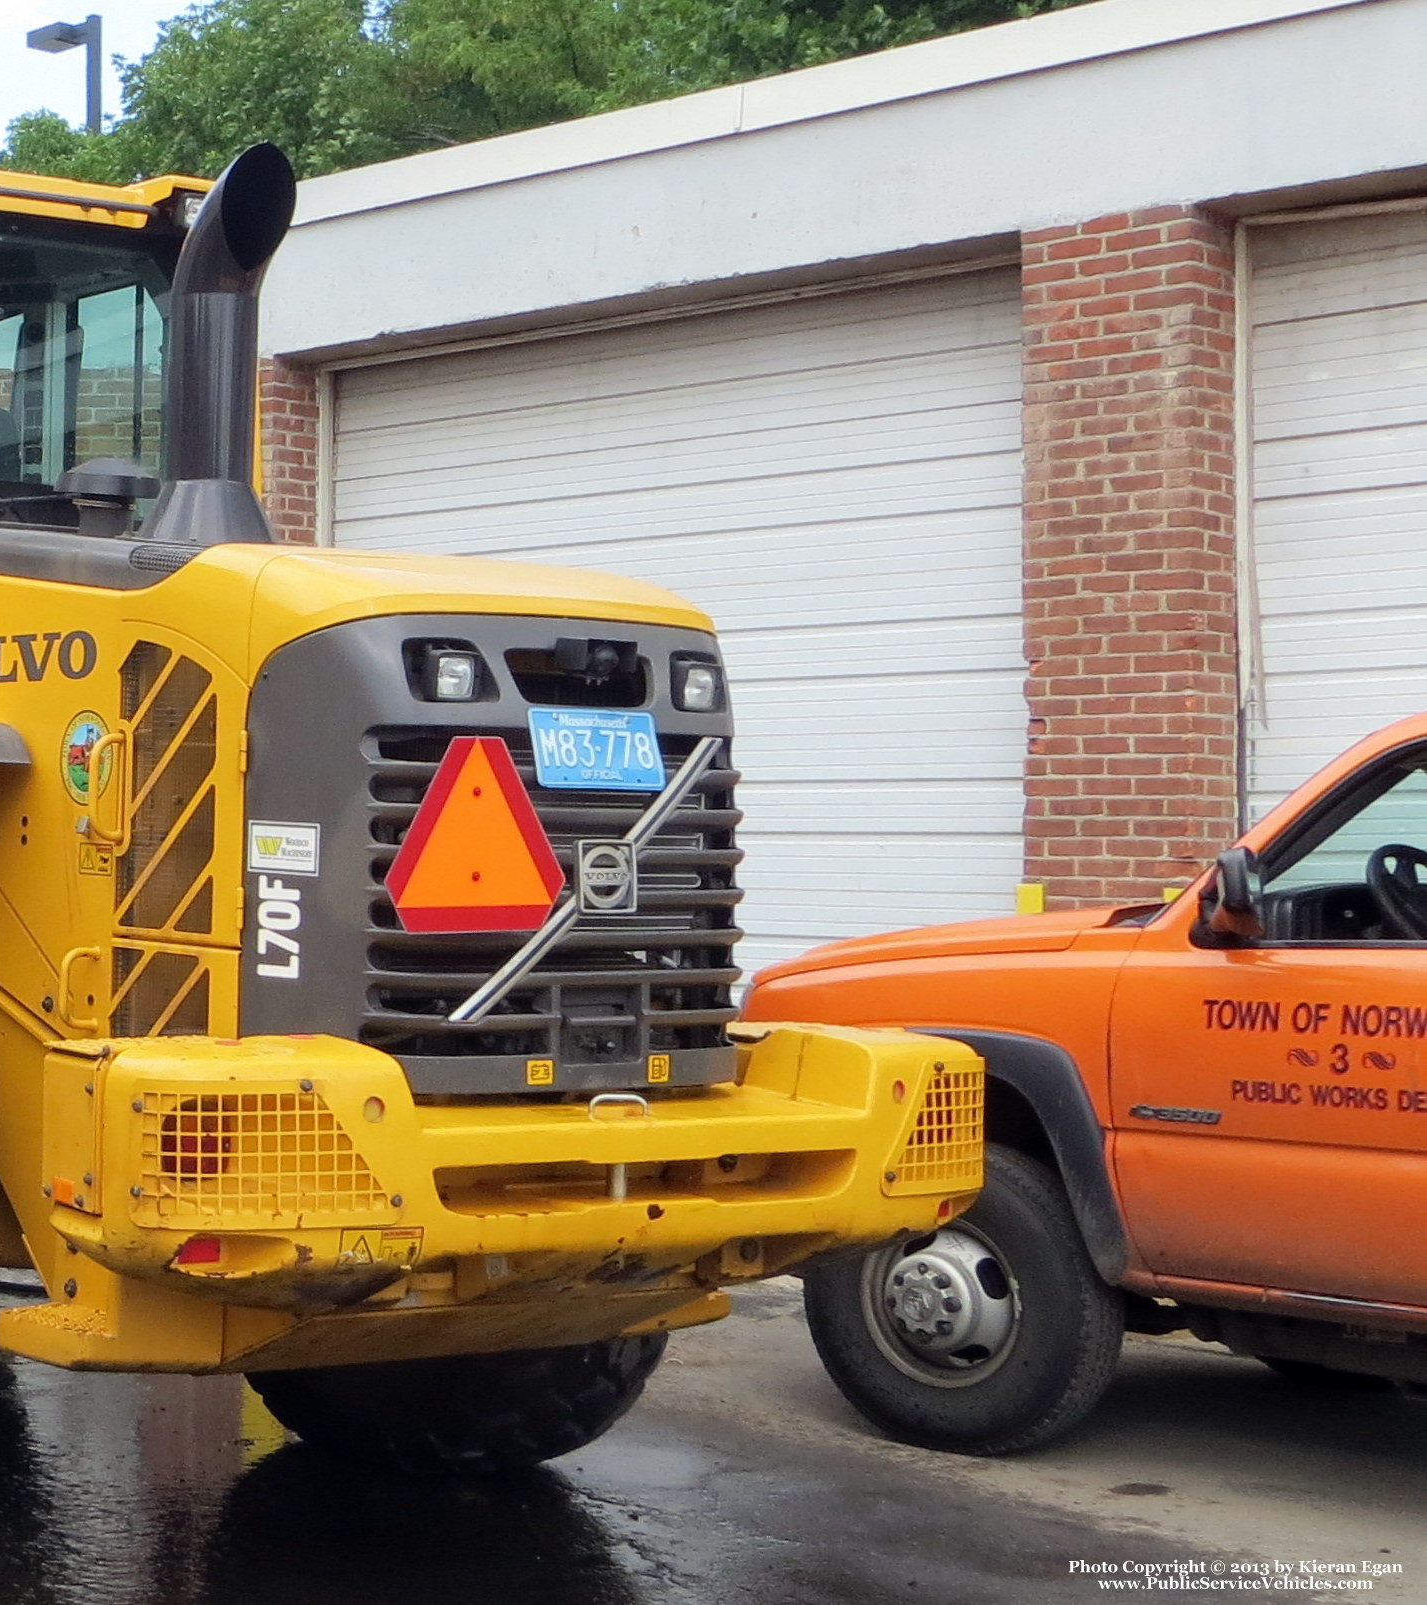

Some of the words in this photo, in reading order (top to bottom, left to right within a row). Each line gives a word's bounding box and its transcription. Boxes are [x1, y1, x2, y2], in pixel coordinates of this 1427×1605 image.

[581, 769, 623, 780] OFFICIAL
[583, 871, 628, 881] VOLVO
[256, 875, 301, 979] L70F
[1203, 1000, 1280, 1032] TOWN
[1291, 1002, 1331, 1034] OF
[1341, 1004, 1427, 1038] NORW
[1330, 1043, 1349, 1075] 3
[1231, 1079, 1302, 1105] PUBLIC
[1310, 1084, 1388, 1110] WORKS
